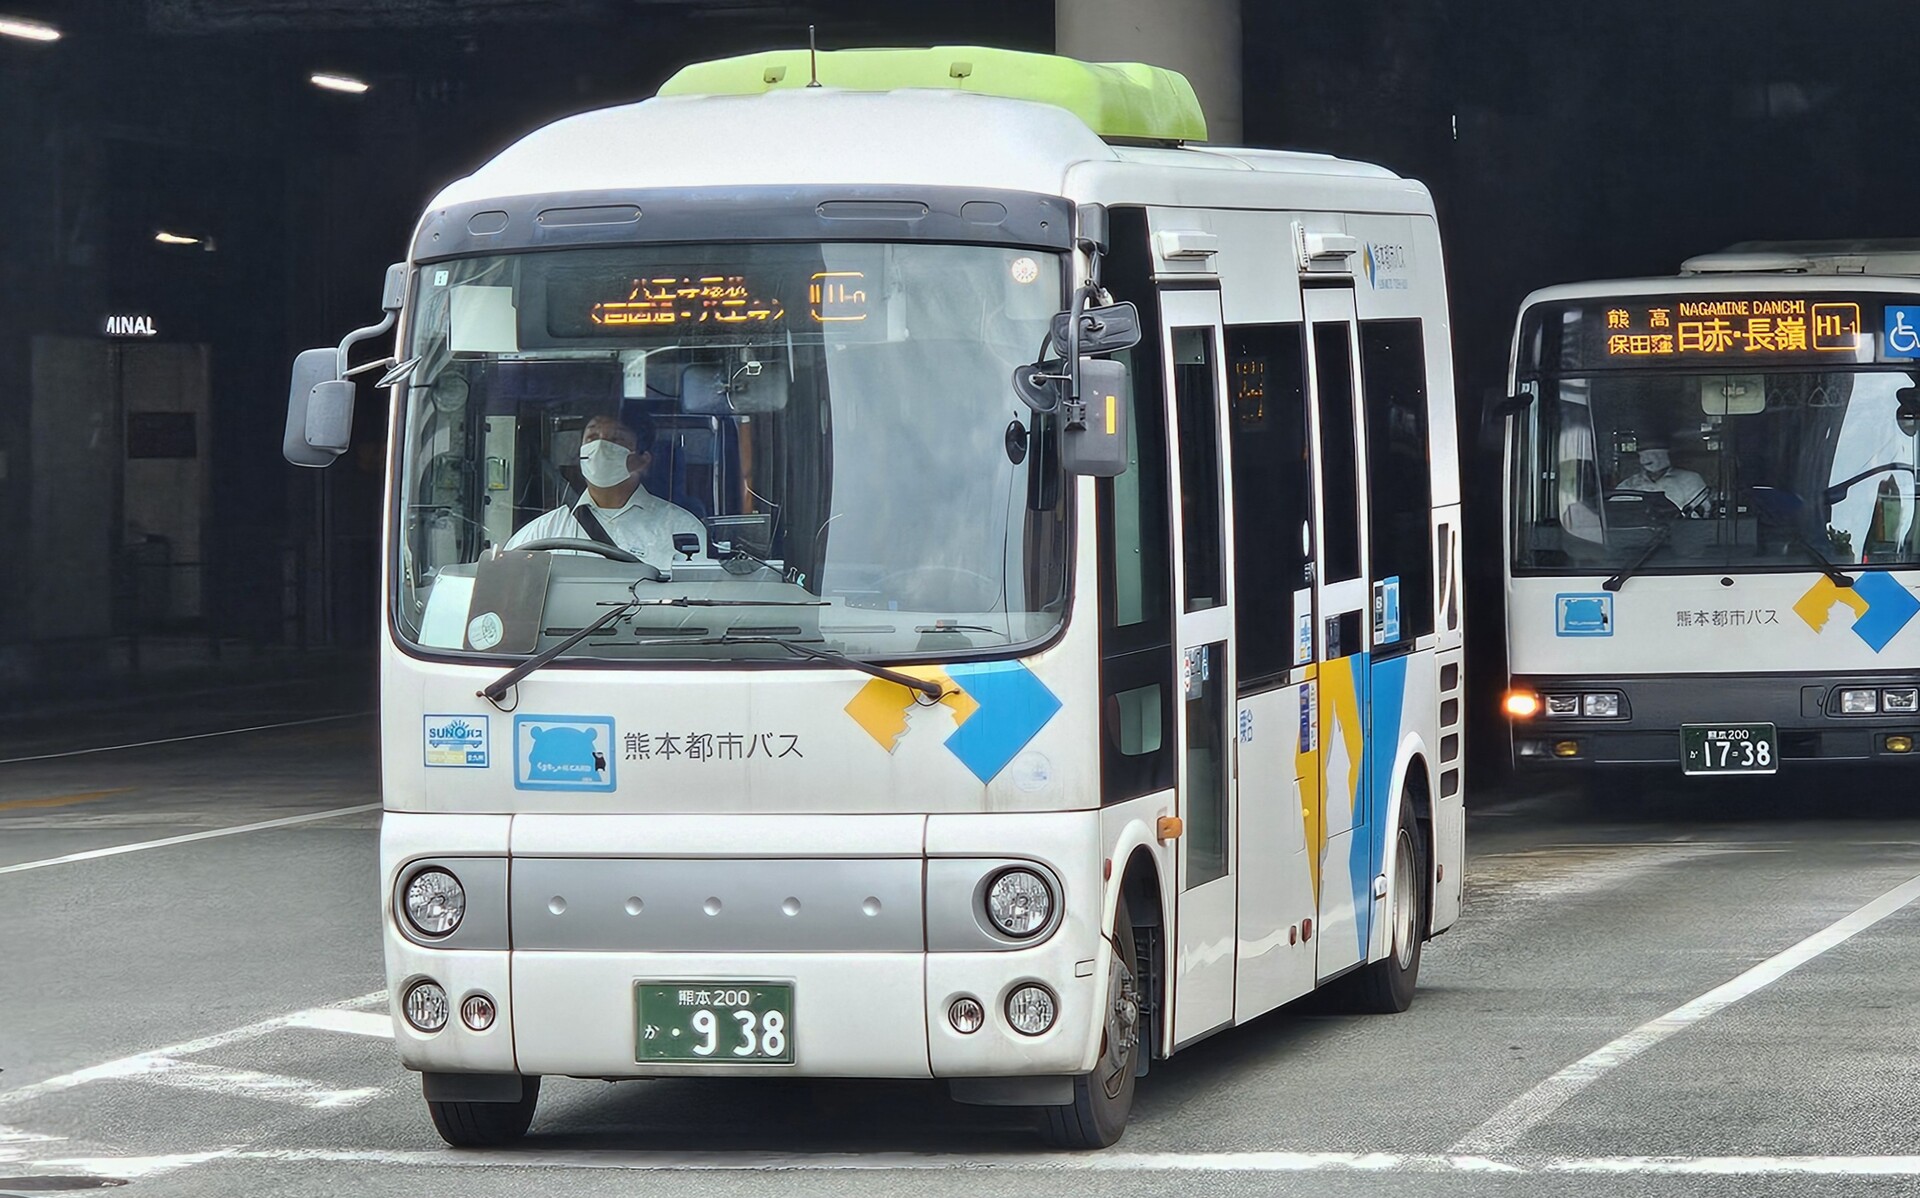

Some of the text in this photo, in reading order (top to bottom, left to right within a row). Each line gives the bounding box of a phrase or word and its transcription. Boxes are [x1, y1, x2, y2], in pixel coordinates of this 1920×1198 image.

[1680, 299, 1806, 316] NAGAMINE DANCHI
[1816, 314, 1857, 336] H1-1
[1607, 334, 1674, 355] 保田窪
[1676, 609, 1780, 628] 熊本都市バス
[623, 732, 804, 763] 熊本都市バス
[1704, 740, 1771, 767] 17-38
[678, 990, 750, 1006] 熊本200
[644, 1024, 660, 1040] か
